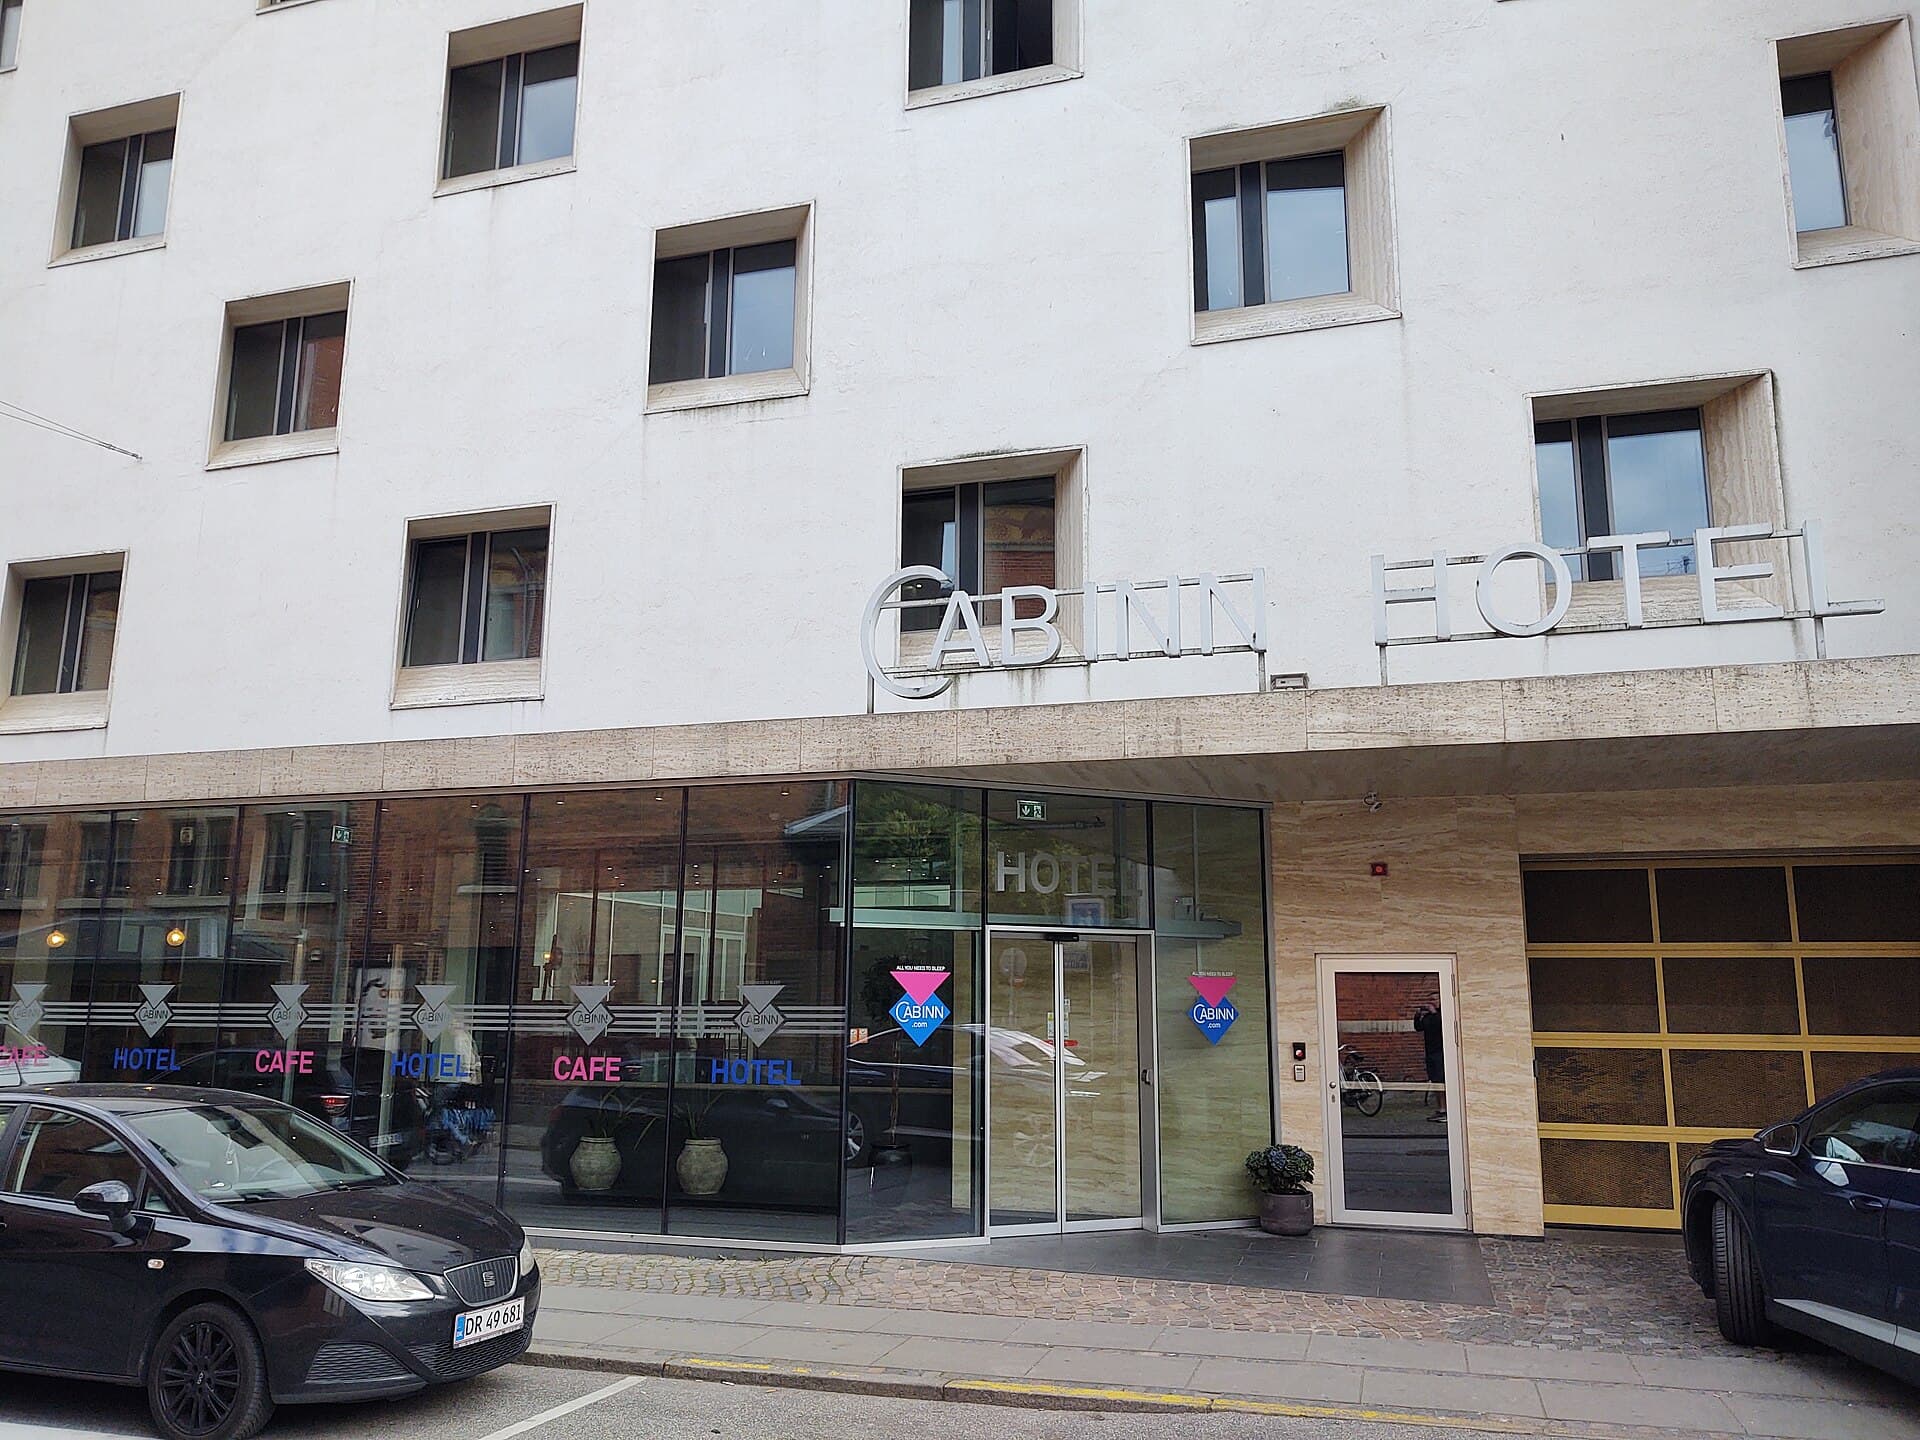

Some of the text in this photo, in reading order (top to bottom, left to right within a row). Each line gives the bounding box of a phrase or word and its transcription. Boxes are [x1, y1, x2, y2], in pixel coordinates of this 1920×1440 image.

[860, 519, 1885, 698] CABINN HOTEL
[138, 1007, 169, 1022] CABINN
[272, 1007, 304, 1023] CABIN
[572, 1010, 609, 1027] CABINN
[740, 1011, 779, 1028] CABINN
[895, 1001, 944, 1023] CABINN
[1193, 1003, 1234, 1024] CABINN
[113, 1047, 181, 1072] HOTEL
[255, 1049, 315, 1074] CAFE
[390, 1051, 470, 1078] HOTEL
[553, 1055, 622, 1082] CAFE
[711, 1058, 801, 1086] HOTEL
[465, 1303, 521, 1336] DR 49 681
